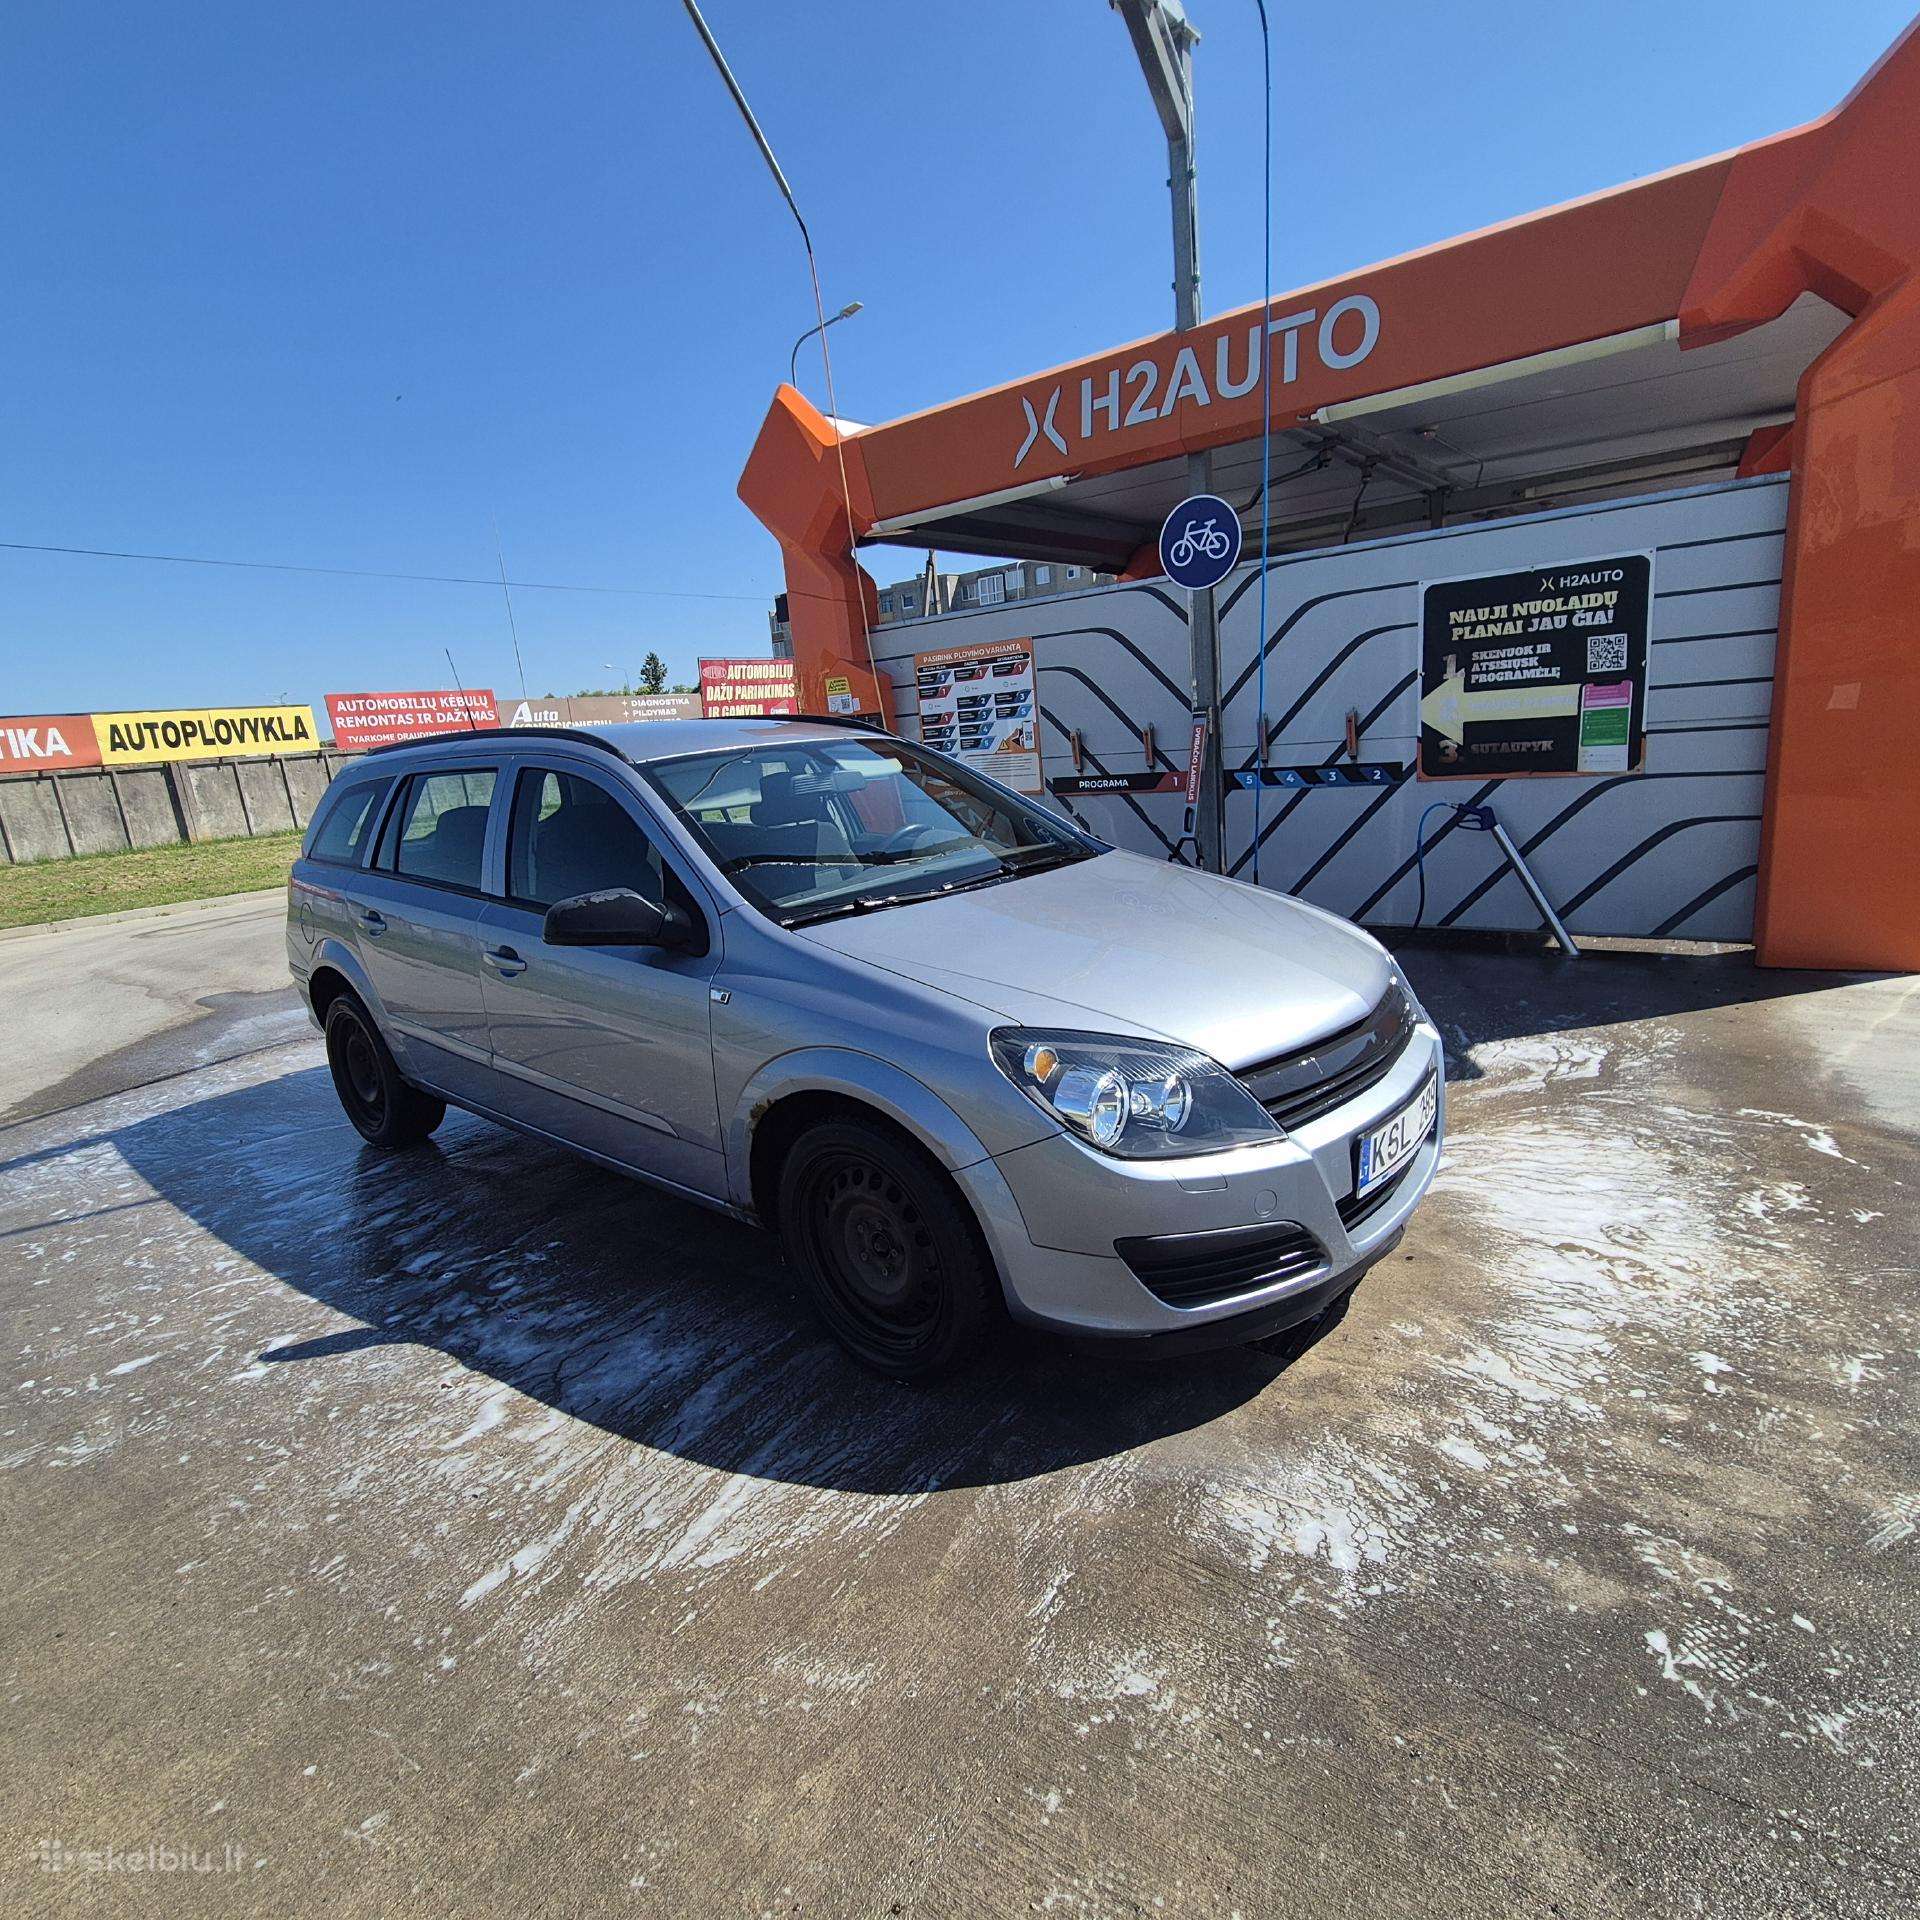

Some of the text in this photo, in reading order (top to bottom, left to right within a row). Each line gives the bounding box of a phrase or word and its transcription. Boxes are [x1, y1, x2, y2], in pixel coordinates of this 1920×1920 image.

[1081, 294, 1381, 438] H2AUTO
[1559, 569, 1624, 588] H2AUTO
[1449, 590, 1619, 625] NAUJI NUOLAIDŲ
[1451, 609, 1615, 641] PLANAI JAU ČIA!
[923, 653, 953, 663] PASIRINK
[953, 649, 985, 659] PLOVIMO
[1471, 643, 1552, 661] SKENUOK IR
[727, 664, 794, 680] AUTOMOBILIŲ
[706, 683, 795, 702] DAŽŲ PARINKIMAS
[337, 694, 489, 711] AUTOMOBILIŲ KĖBULŲ
[335, 707, 496, 728] REMONTAS IR DAŽYMAS
[632, 708, 677, 717] PILDYMAS
[109, 715, 310, 752] AUTOPLOVYKLA
[346, 734, 395, 744] TVARKOME
[1078, 778, 1129, 789] PROGRAMA
[1172, 776, 1178, 787] 1
[1246, 770, 1381, 785] 5 4 3 2
[1371, 1116, 1412, 1174] KSL
